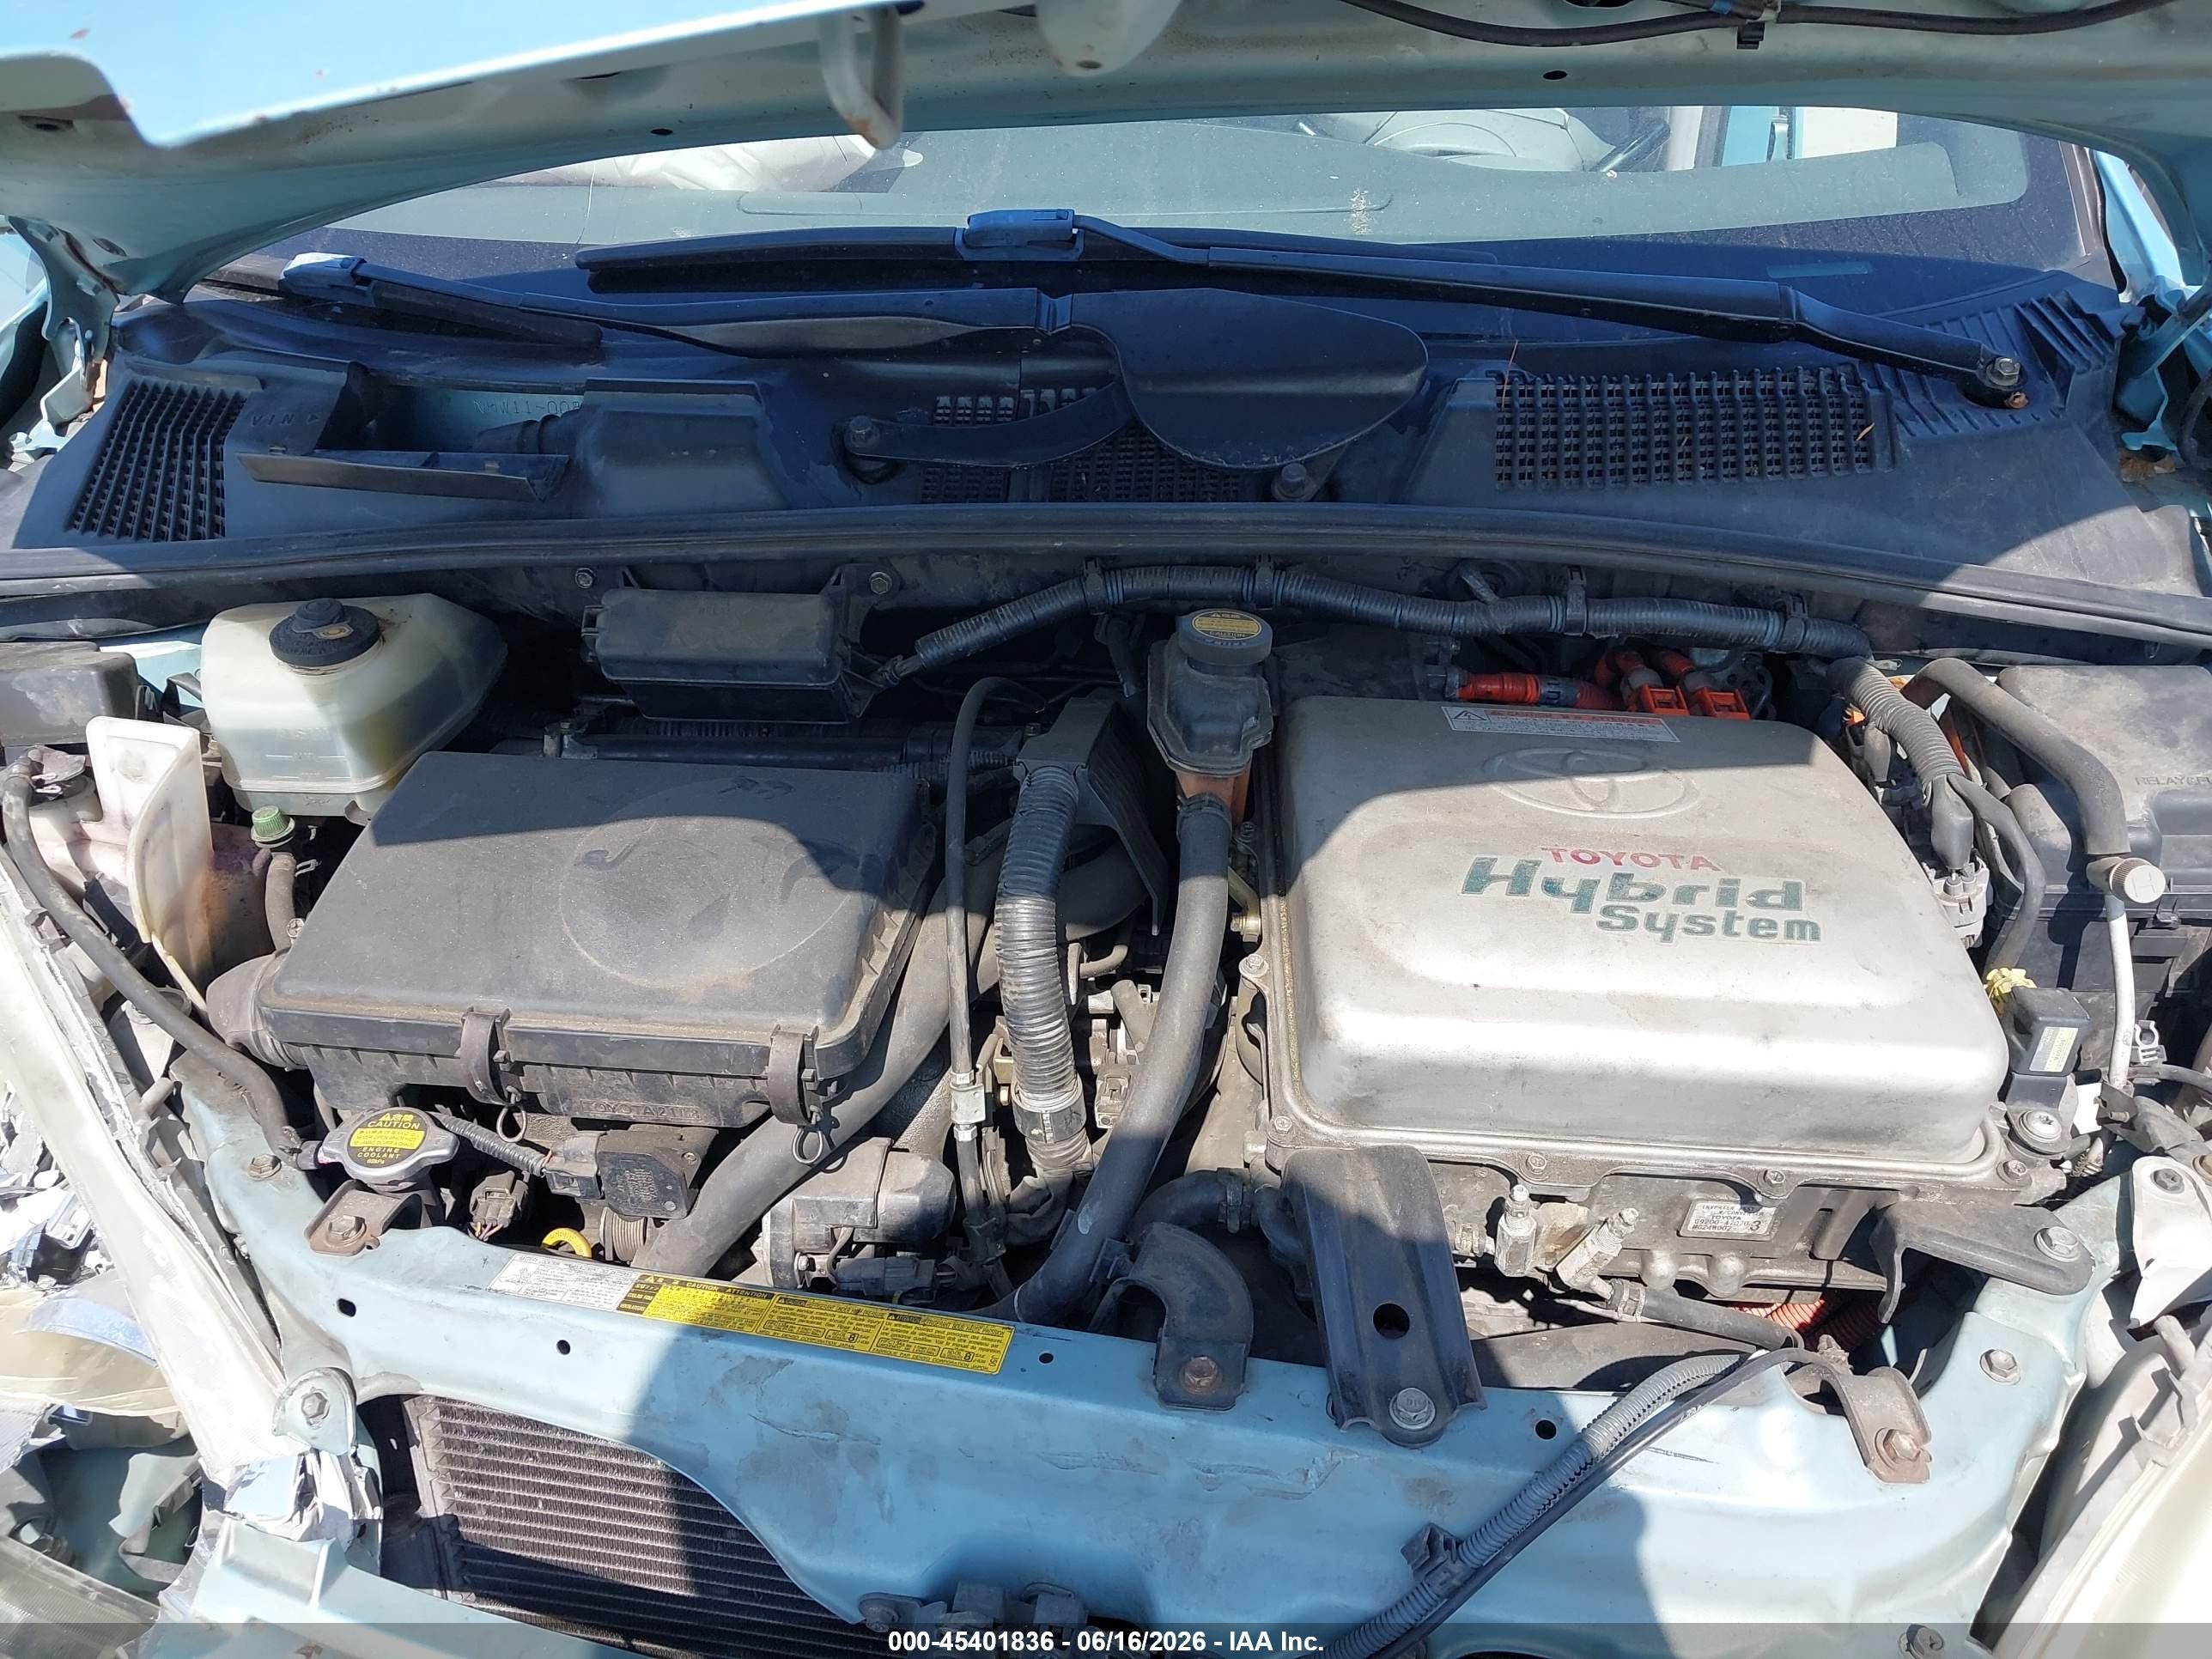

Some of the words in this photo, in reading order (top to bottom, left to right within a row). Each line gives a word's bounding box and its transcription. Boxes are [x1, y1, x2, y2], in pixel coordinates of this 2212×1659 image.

[250, 414, 293, 427] VIN
[1541, 847, 1721, 872] TOYOTA
[1461, 856, 1804, 915] Hybrid
[1595, 904, 1822, 944] System
[368, 1121, 421, 1129] CAUTION
[1750, 1220, 1761, 1231] 3
[686, 1281, 720, 1292] CAUTION
[726, 1287, 769, 1299] ATTENTION
[847, 1333, 856, 1341] 8
[963, 1352, 972, 1361] 8
